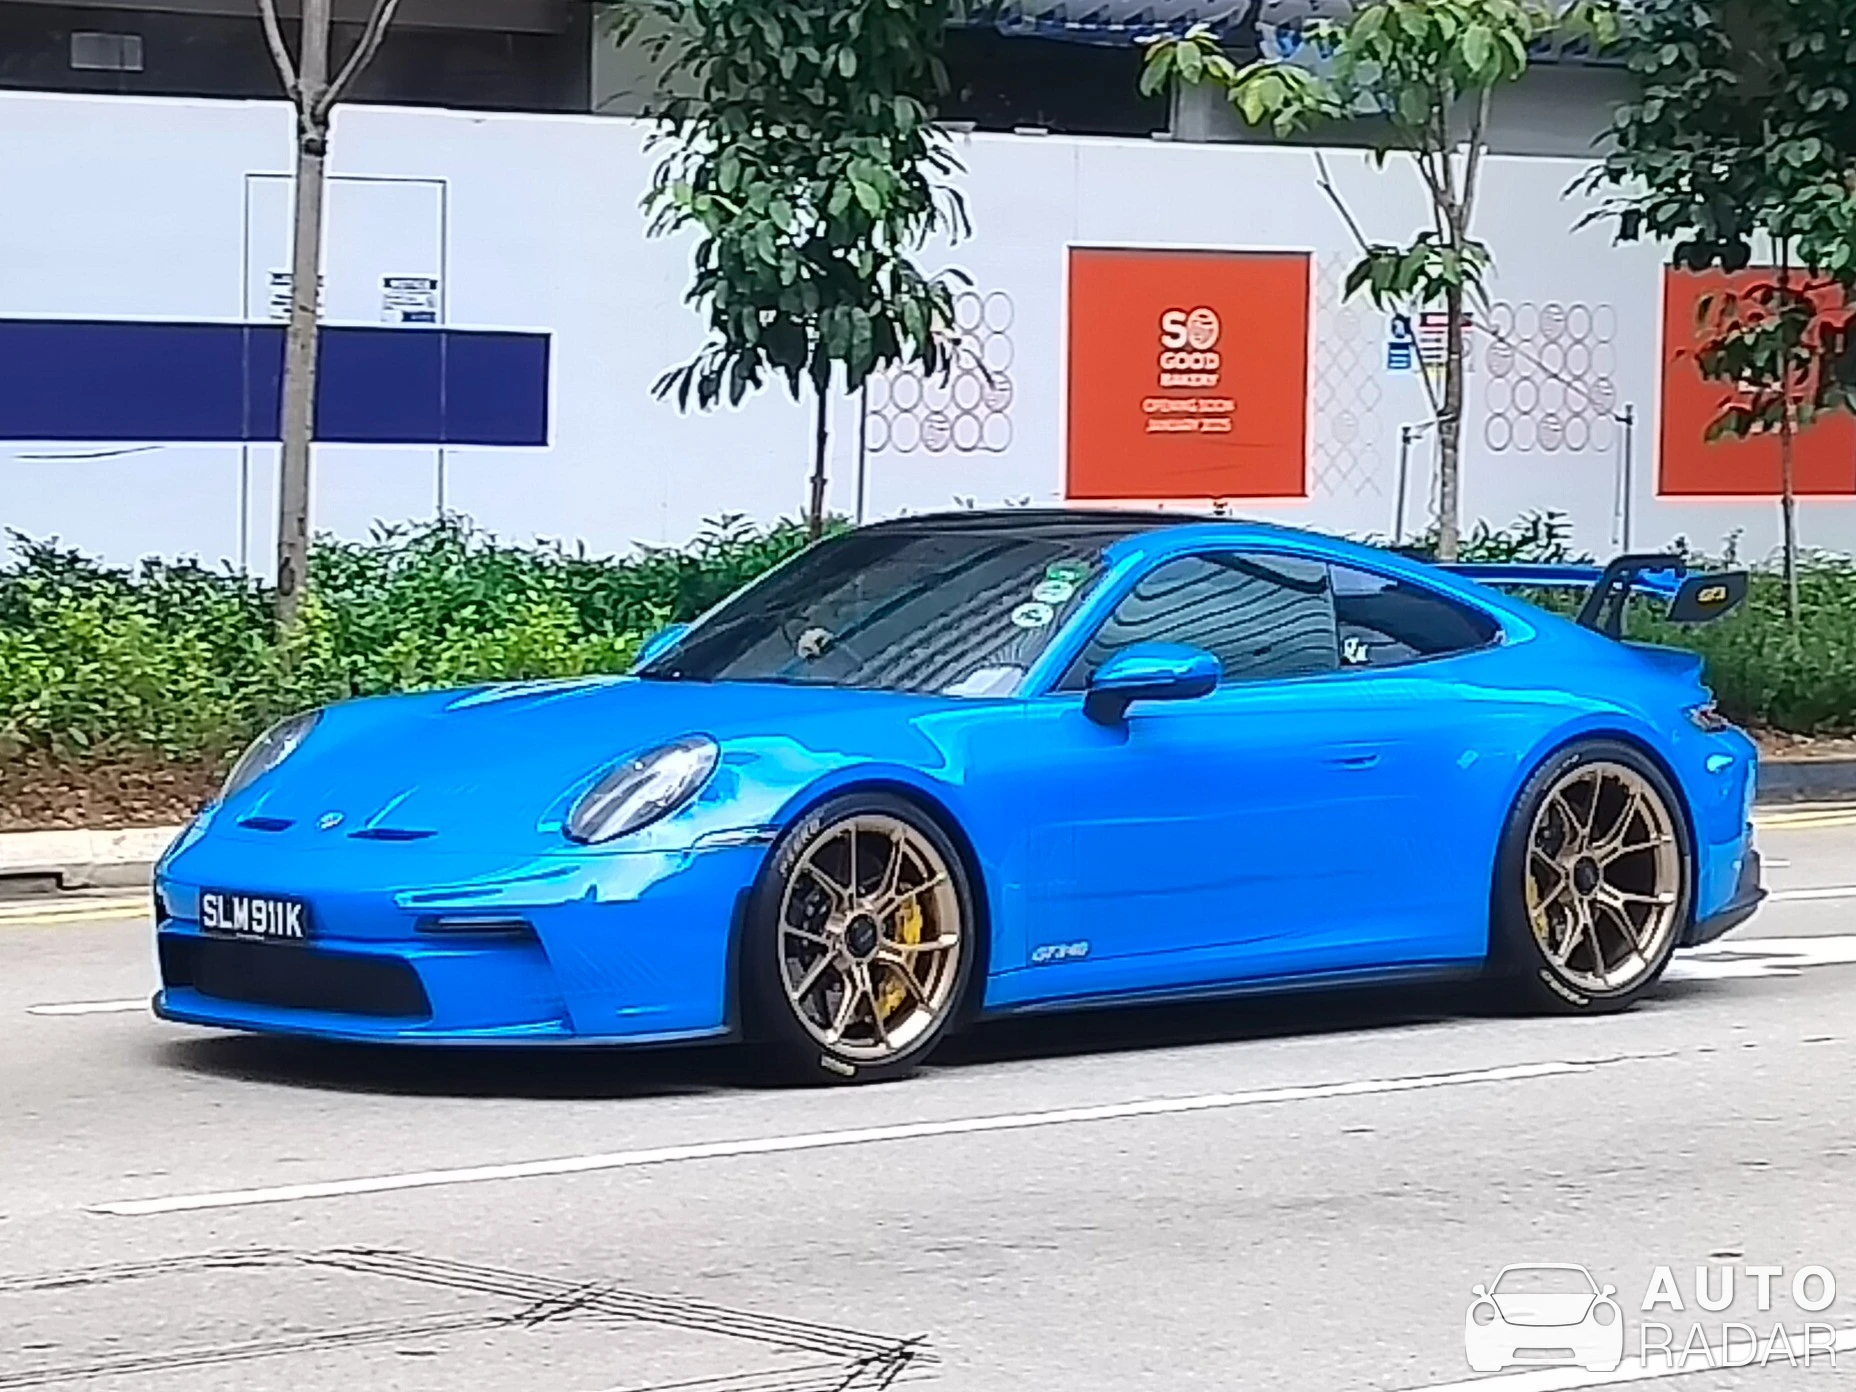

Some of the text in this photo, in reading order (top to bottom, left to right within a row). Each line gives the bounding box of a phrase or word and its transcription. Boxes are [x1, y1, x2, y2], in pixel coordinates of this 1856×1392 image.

[1160, 307, 1219, 350] SO
[1159, 352, 1220, 370] GOOD
[1160, 372, 1219, 387] BAKERY
[203, 893, 303, 938] SLM911K
